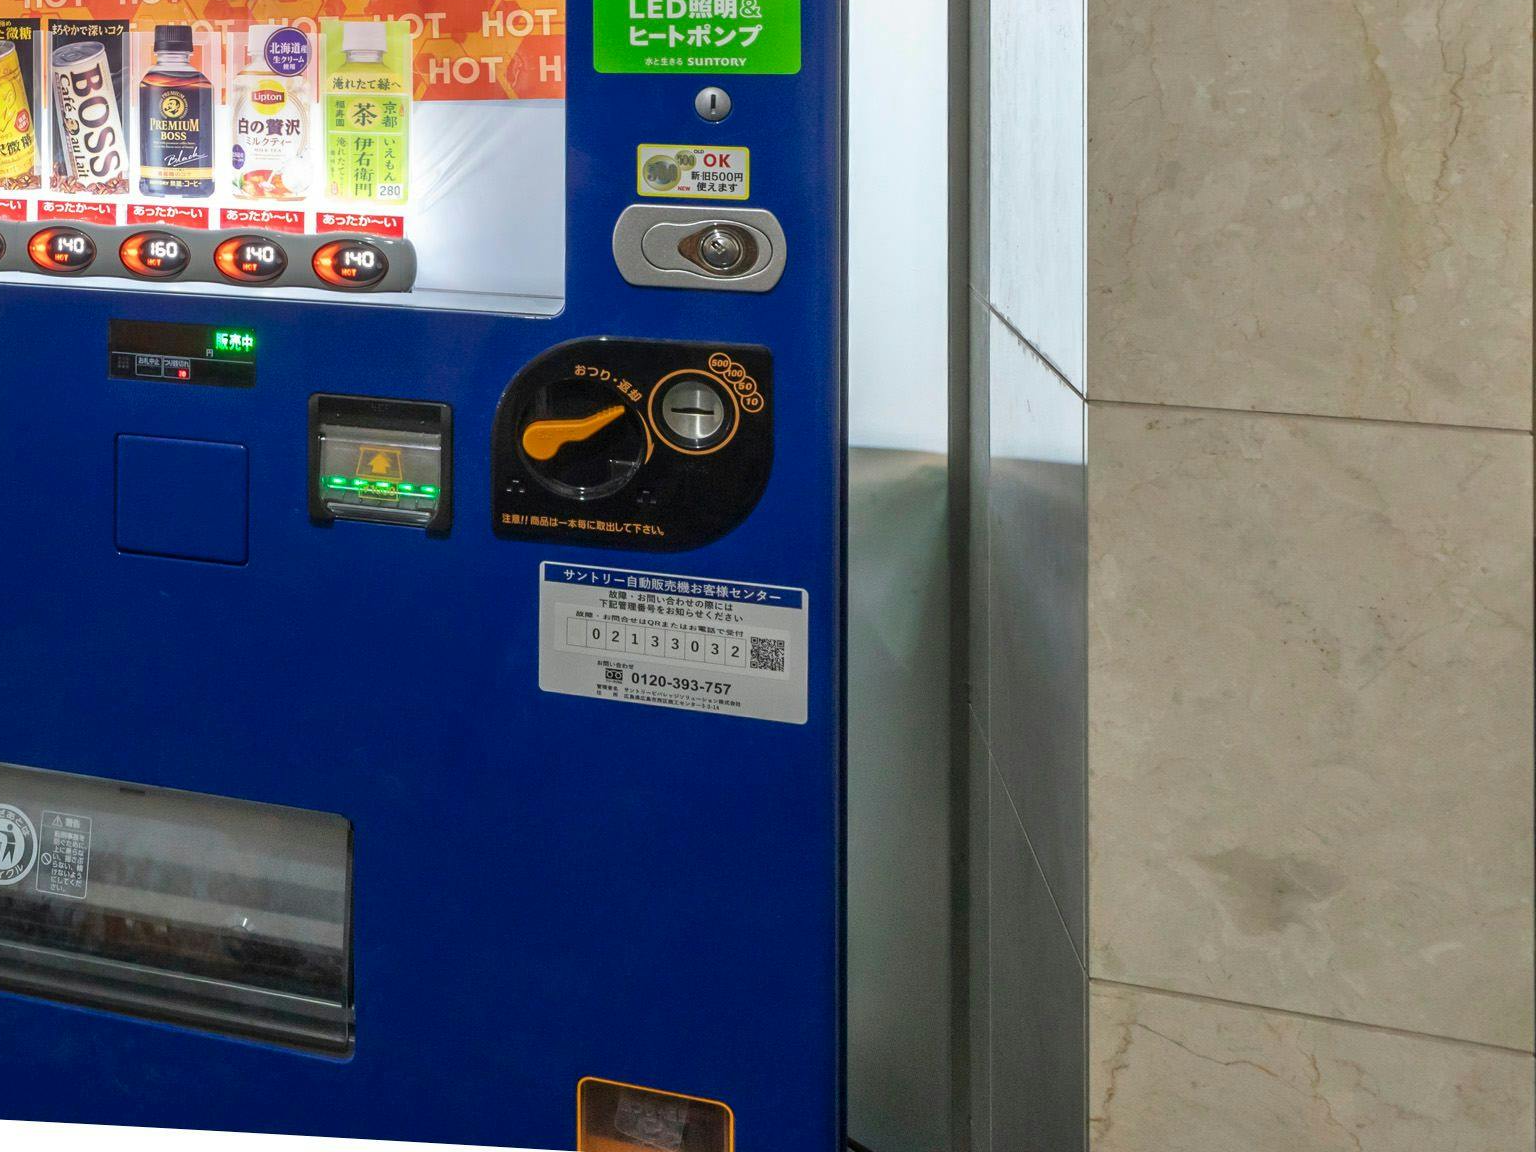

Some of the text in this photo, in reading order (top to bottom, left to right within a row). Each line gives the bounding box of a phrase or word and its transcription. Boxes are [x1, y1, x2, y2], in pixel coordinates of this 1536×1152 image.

[52, 23, 125, 37] まろやかで深いコク
[481, 8, 556, 38] HOT
[629, 23, 763, 48] ヒートポンプ
[273, 56, 305, 64] 生クリーム
[645, 57, 747, 67] 水と生きる SUNTORY
[429, 56, 503, 85] HOT
[332, 77, 401, 90] 淹れたて緑へ
[253, 91, 283, 102] Lipton
[70, 63, 121, 177] BOSS
[352, 102, 378, 127] 茶
[382, 100, 398, 129] 京都
[149, 117, 199, 132] PREMIUM
[238, 117, 301, 136] 白の贅沢
[161, 131, 187, 141] BOSS
[245, 136, 292, 146] ミルクティー
[353, 136, 375, 197] 伊右衛門
[384, 138, 396, 182] いえもん
[703, 153, 731, 168] OK
[379, 185, 401, 196] 280
[696, 182, 739, 192] 使えます
[149, 240, 179, 258] 160
[215, 331, 254, 352] 販売中
[711, 359, 729, 368] 500
[726, 369, 743, 378] 100
[574, 364, 643, 402] おつり・返却
[738, 382, 752, 391] 50
[745, 397, 759, 406] 10
[563, 568, 782, 602] サントリー自動販売機お客様センター
[608, 589, 734, 612] 故障・お問い合わせの際には
[599, 598, 744, 623] 下記管理番号をお知らせください
[597, 660, 634, 670] お問い合わせ
[631, 672, 732, 696] 0120-393-757
